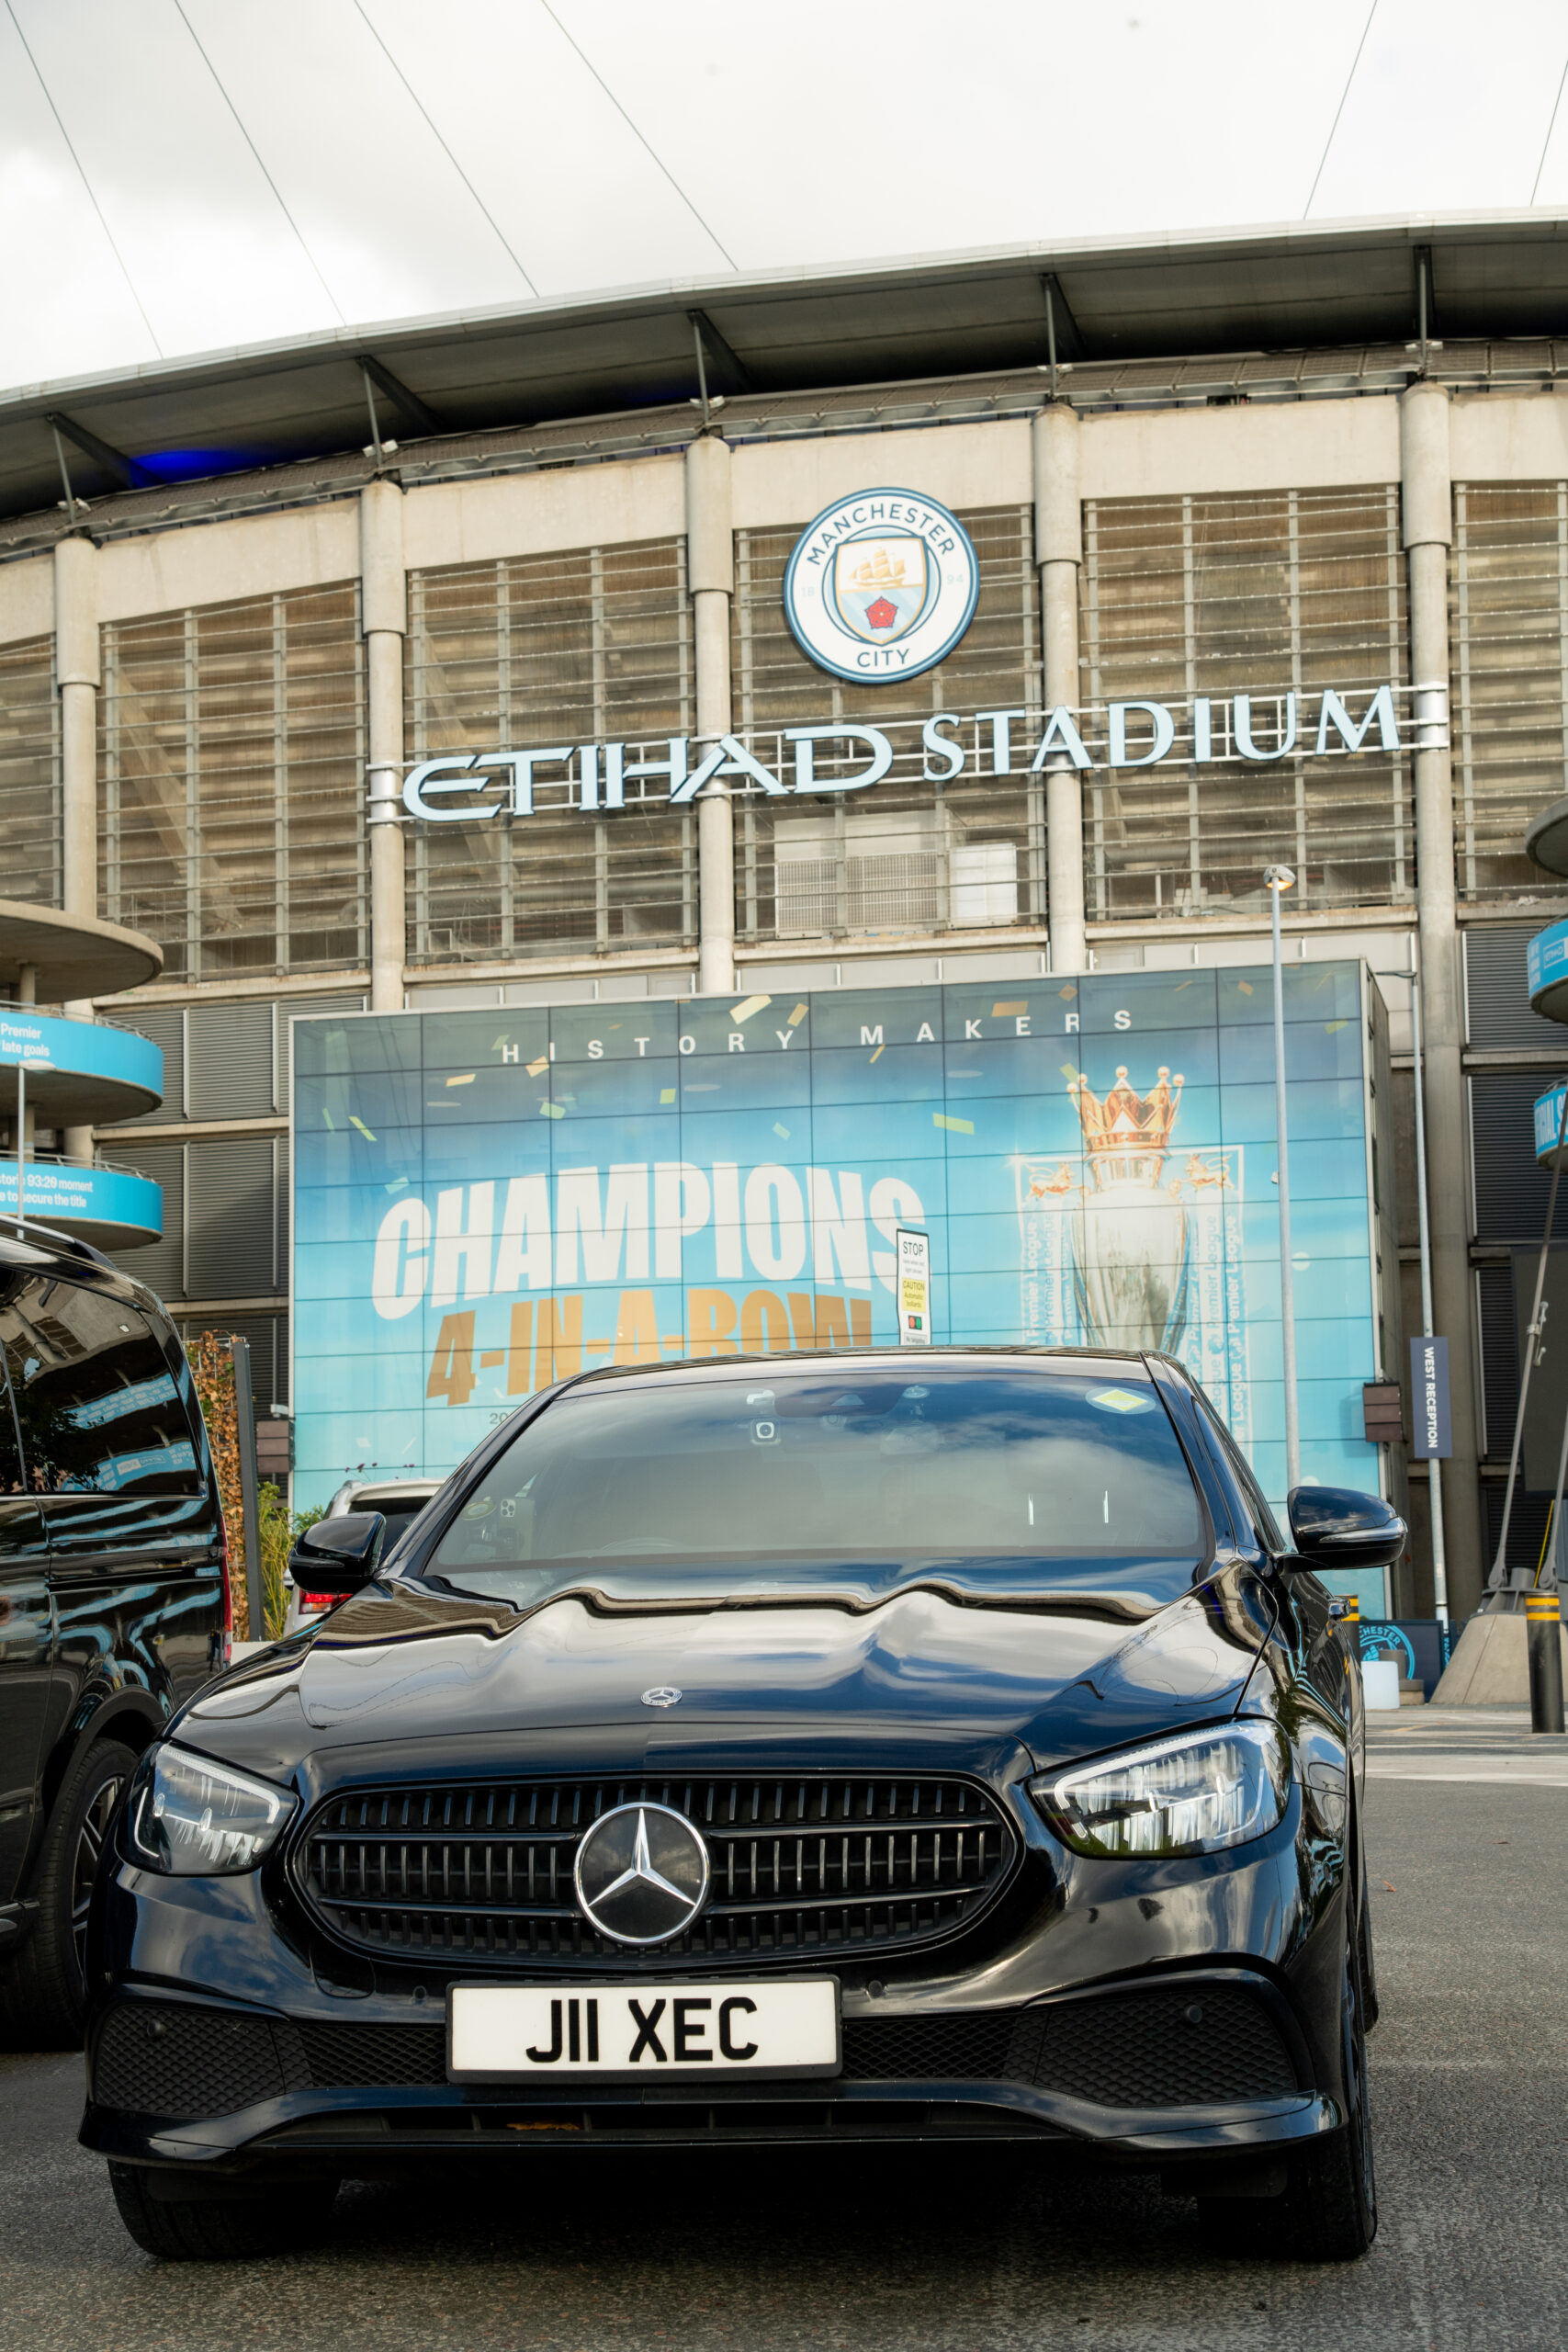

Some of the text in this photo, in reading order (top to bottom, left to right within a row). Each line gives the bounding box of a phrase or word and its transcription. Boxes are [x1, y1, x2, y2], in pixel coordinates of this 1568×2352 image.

[807, 503, 955, 566] MANCHESTER
[856, 648, 910, 669] CITY
[401, 684, 1402, 822] ETIHAD STADIUM
[0, 1023, 42, 1039] Premier
[2, 1039, 51, 1057] late goals
[502, 1010, 1131, 1064] HISTORY MAKERS
[54, 1193, 69, 1206] the
[70, 1194, 87, 1208] title
[372, 1161, 931, 1321] CHAMPIONS
[903, 1241, 924, 1257] STOP
[1225, 1215, 1241, 1273] League
[1023, 1221, 1042, 1337] Premier League
[1226, 1278, 1241, 1334] Premier
[426, 1289, 873, 1407] 4-IN-A-ROW
[1231, 1362, 1247, 1421] League
[1424, 1346, 1438, 1449] WEST RECEPTION
[627, 1996, 759, 2064] XEC
